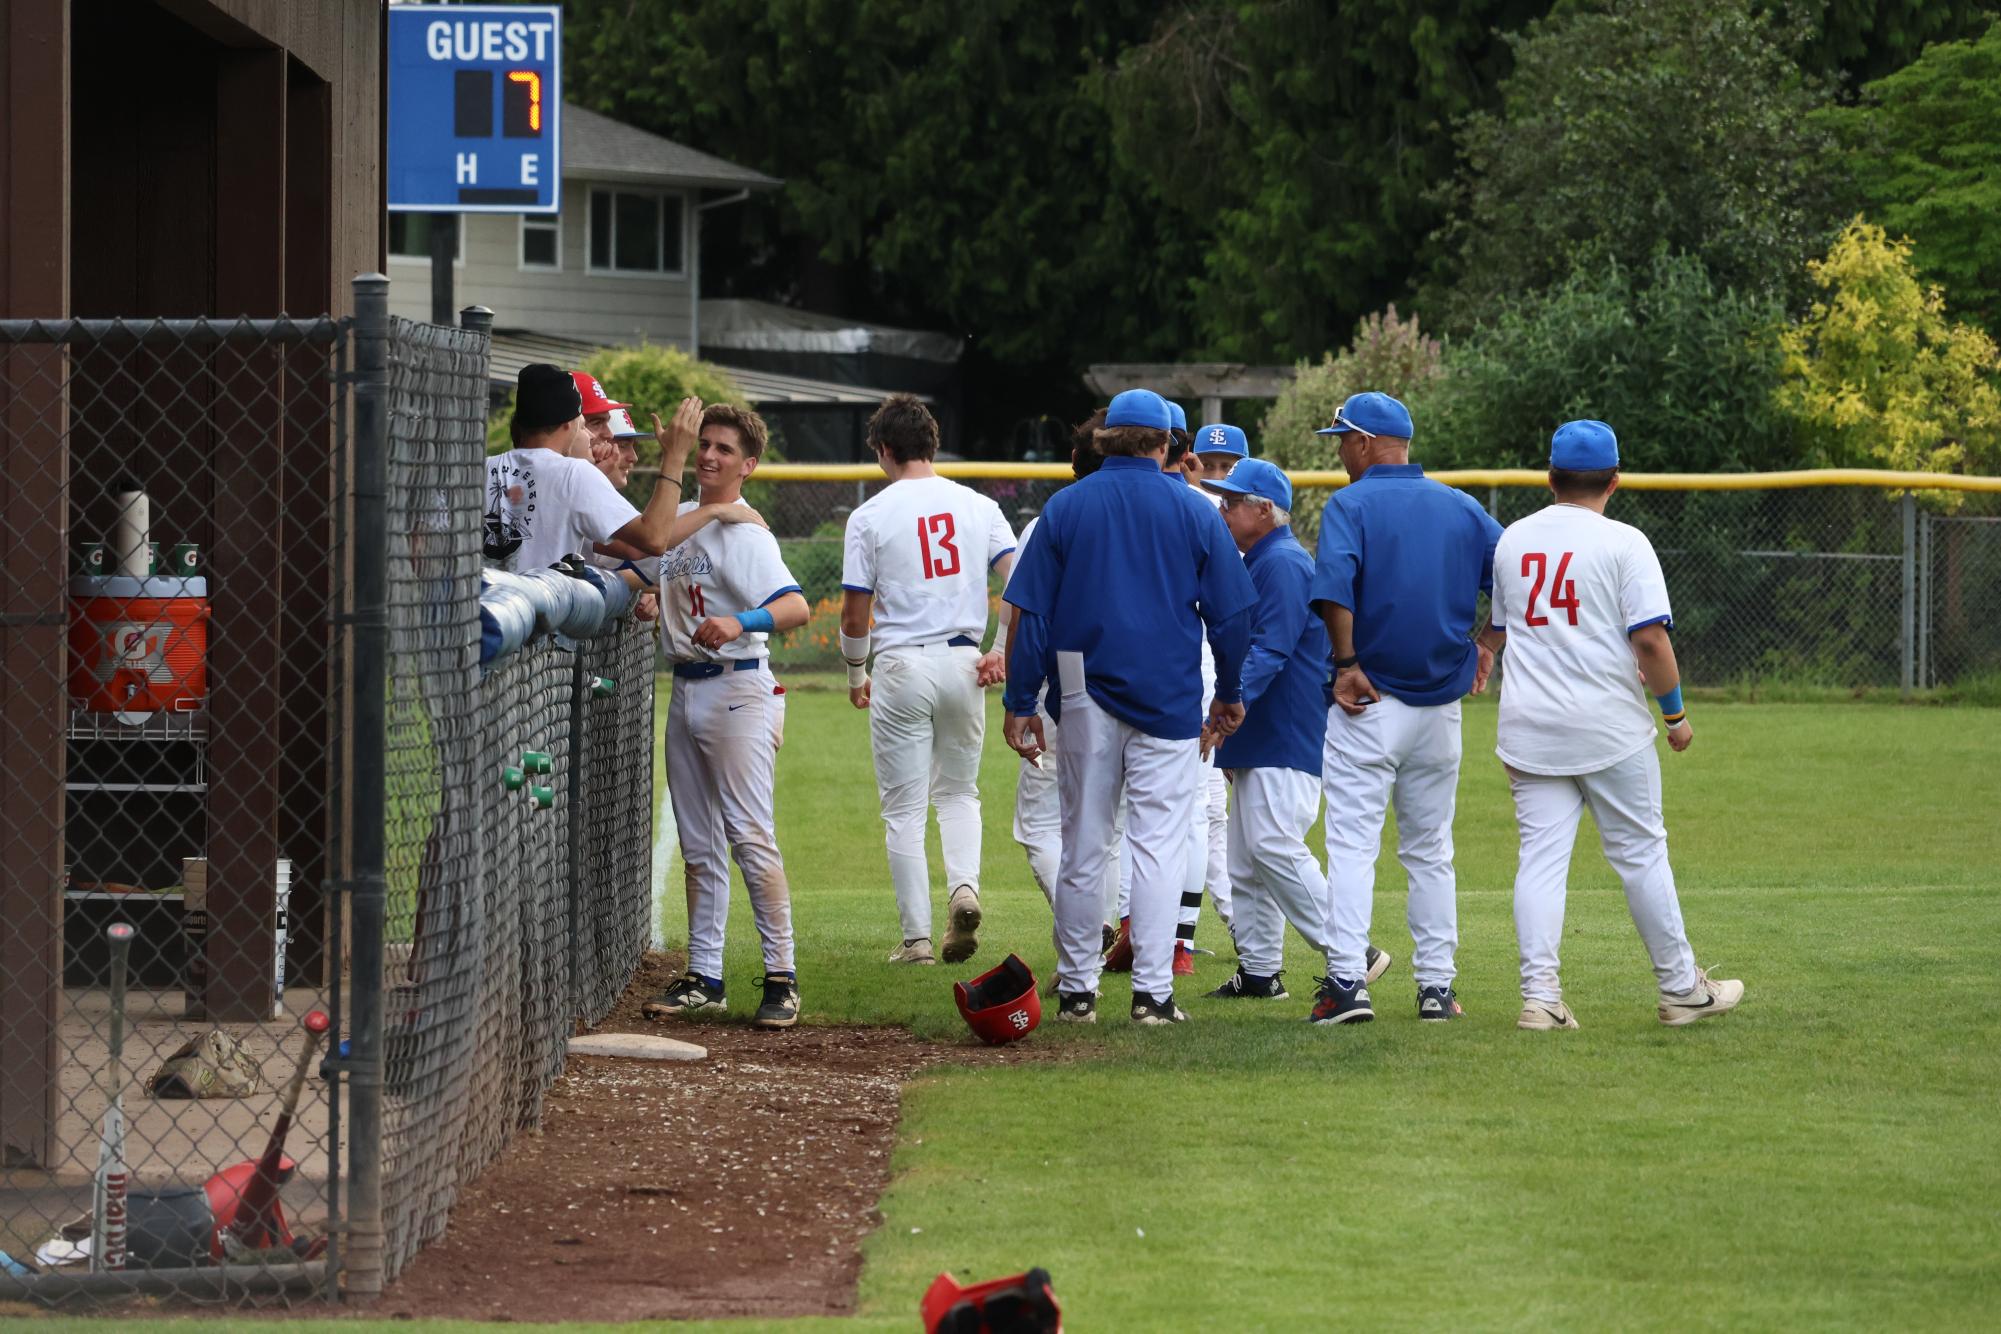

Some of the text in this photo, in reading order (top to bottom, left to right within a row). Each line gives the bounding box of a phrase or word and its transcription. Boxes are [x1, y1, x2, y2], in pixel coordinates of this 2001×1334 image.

[426, 20, 553, 61] GUEST
[508, 70, 541, 131] 7
[456, 152, 539, 185] H E
[917, 512, 961, 579] 13
[688, 584, 706, 617] 11
[1521, 551, 1580, 627] 24
